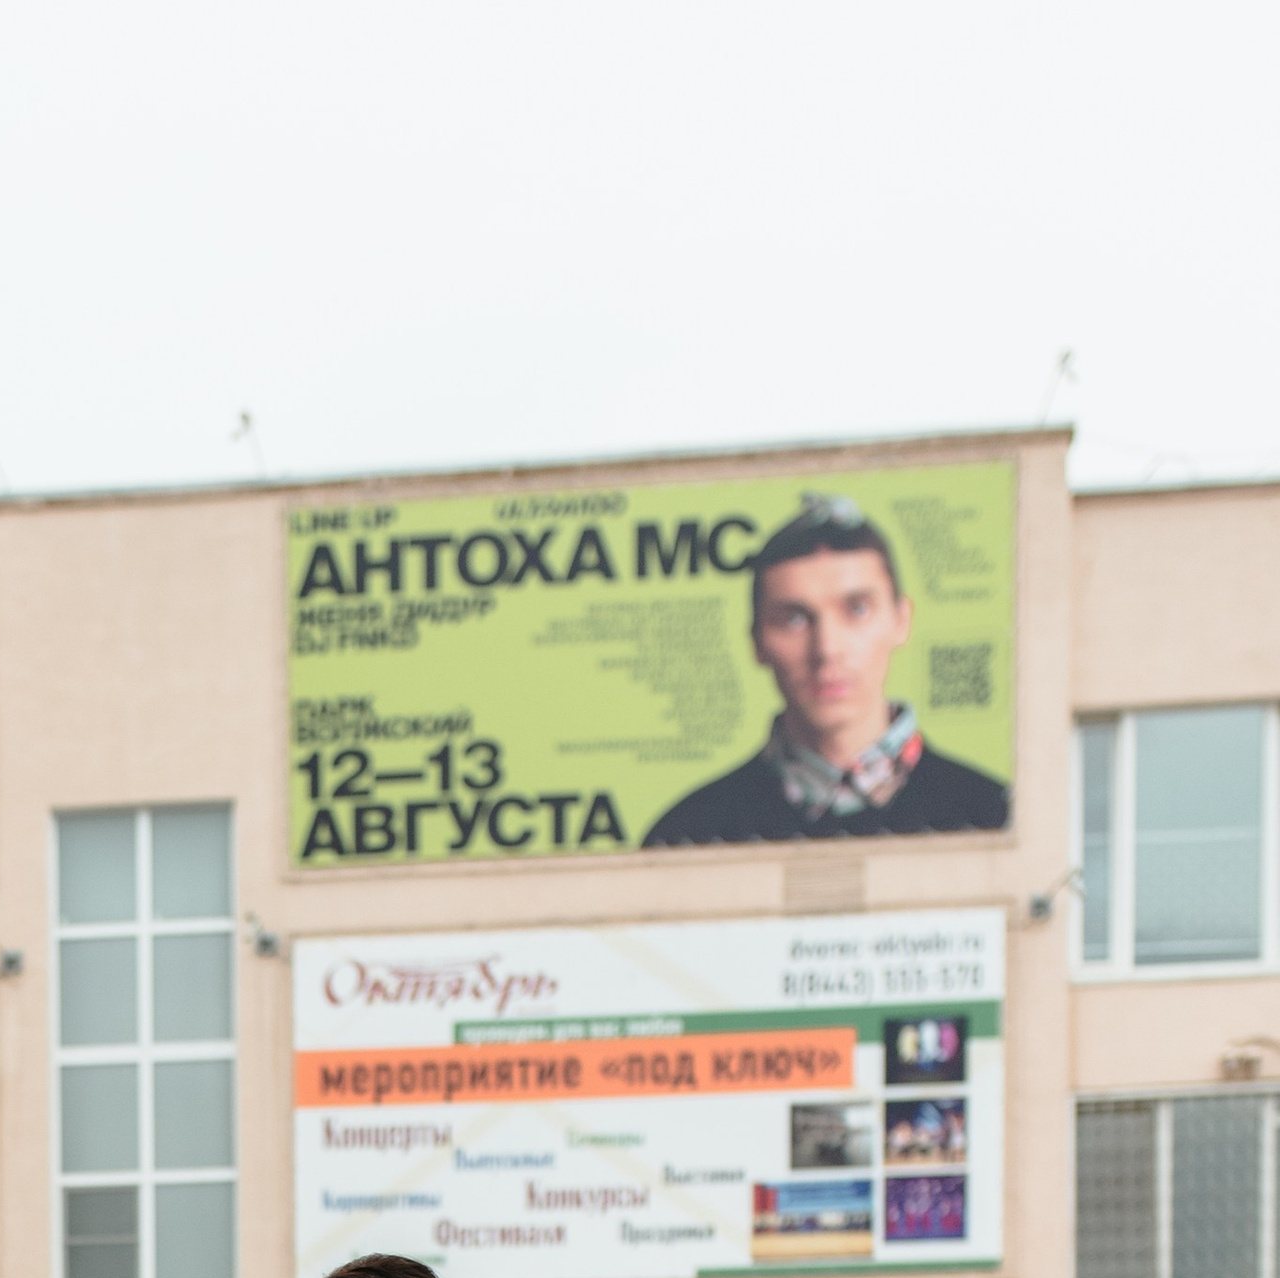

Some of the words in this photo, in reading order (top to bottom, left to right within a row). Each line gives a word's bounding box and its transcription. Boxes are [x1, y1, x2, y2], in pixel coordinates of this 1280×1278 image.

[298, 526, 616, 599] АНТОХА
[301, 792, 626, 859] АВГУСТА
[319, 1055, 582, 1102] мероприятие
[711, 1047, 841, 1084] ключ»
[322, 1119, 453, 1152] Концерты
[524, 1181, 651, 1212] Конкурсы
